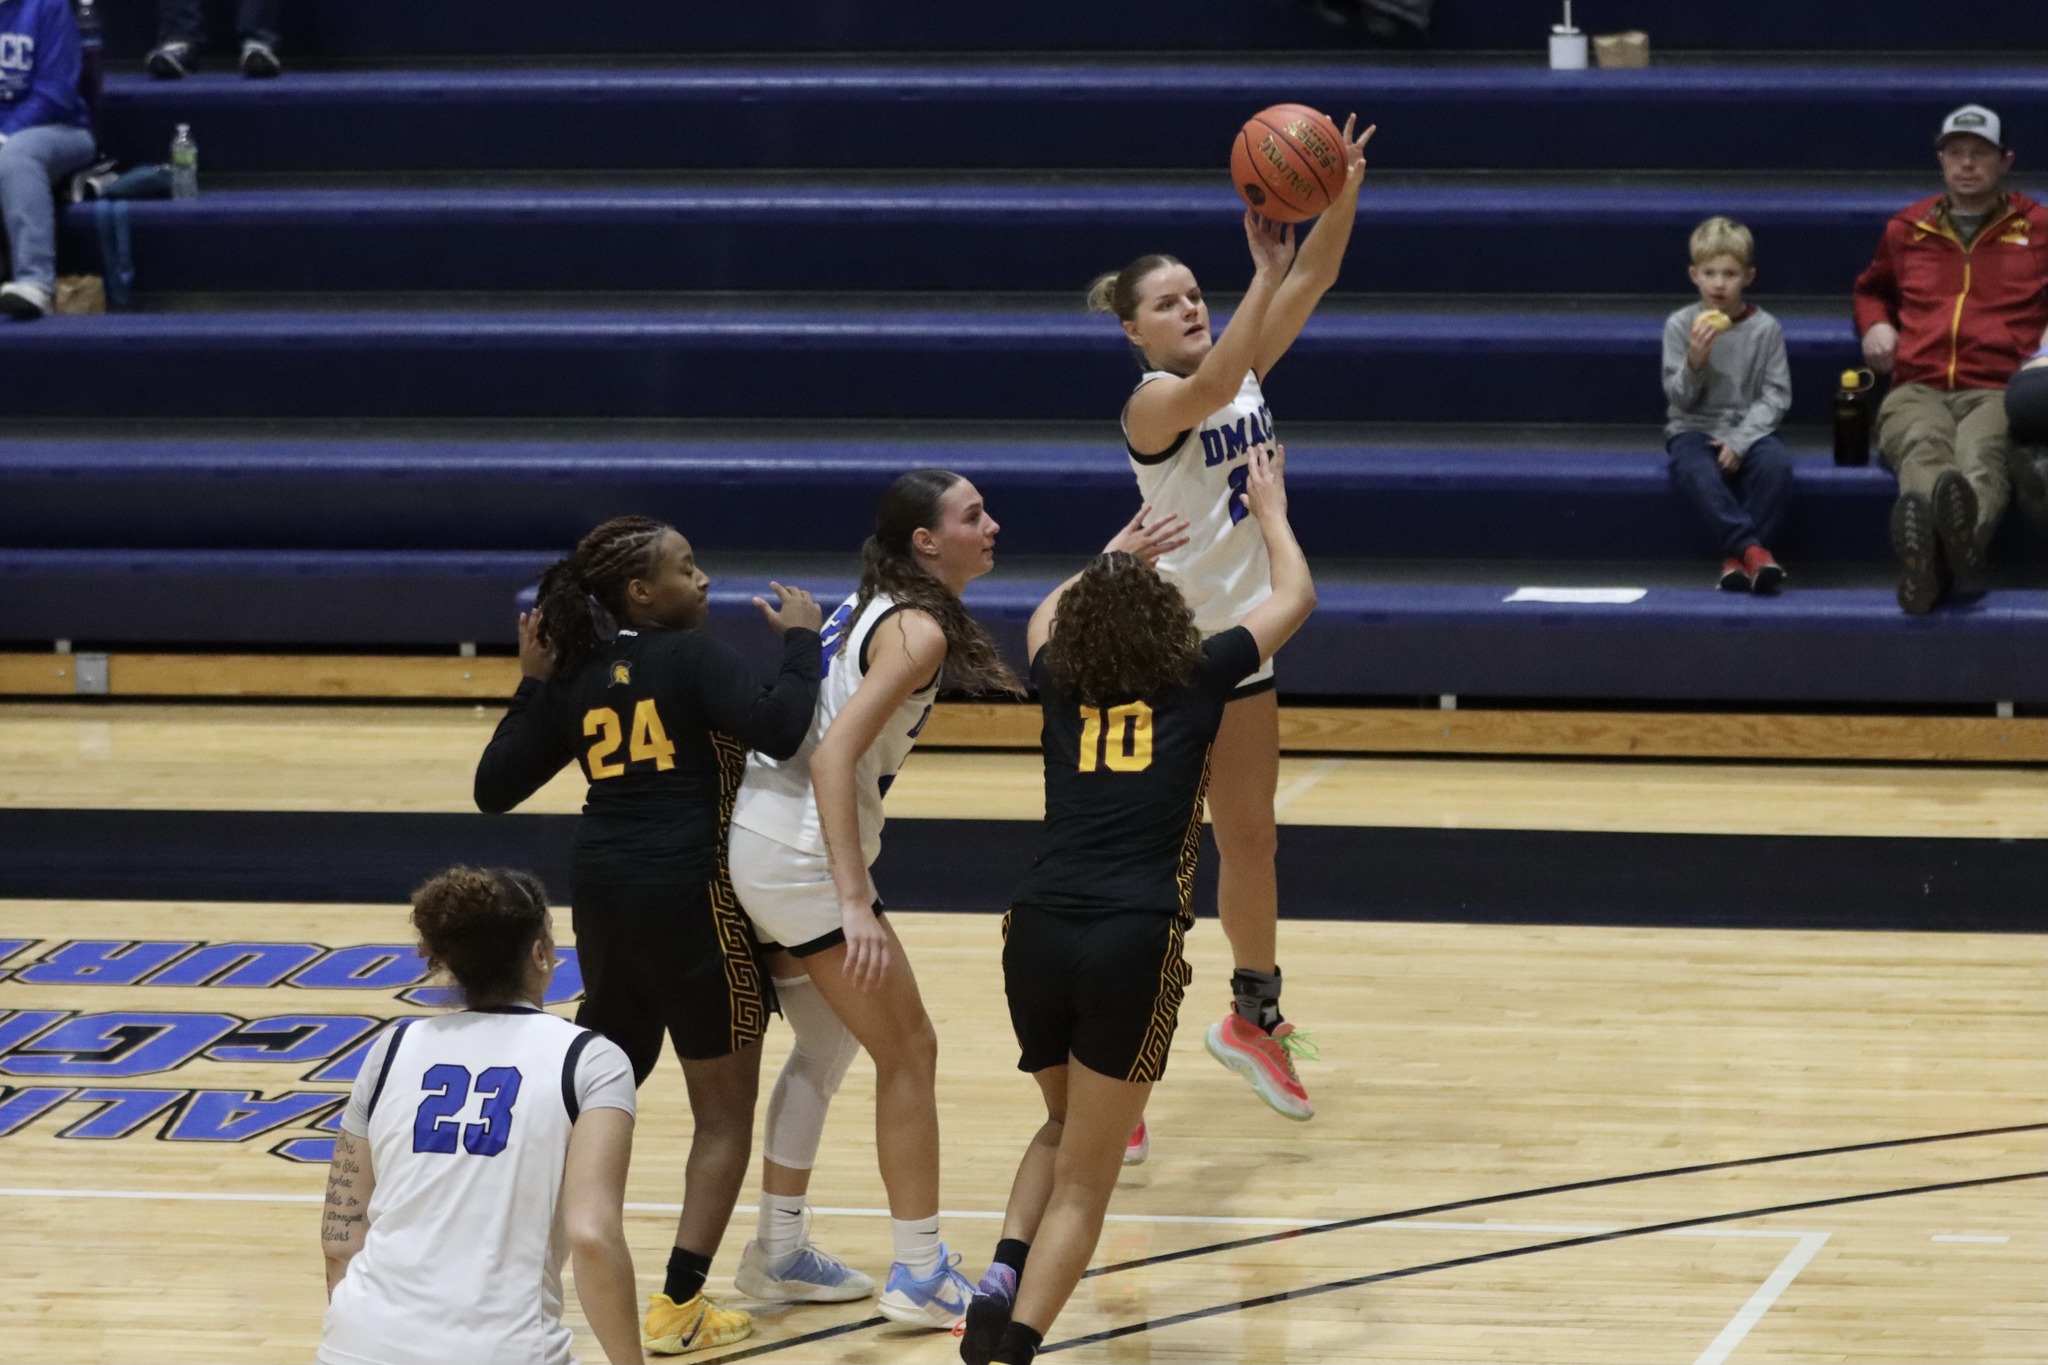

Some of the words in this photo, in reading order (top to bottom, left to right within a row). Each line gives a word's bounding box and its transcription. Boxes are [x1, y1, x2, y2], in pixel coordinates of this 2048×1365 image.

[1258, 134, 1317, 202] SPALDING
[1200, 405, 1274, 468] DMAC
[582, 699, 676, 780] 24
[1078, 700, 1153, 772] 10
[412, 1063, 523, 1157] 23
